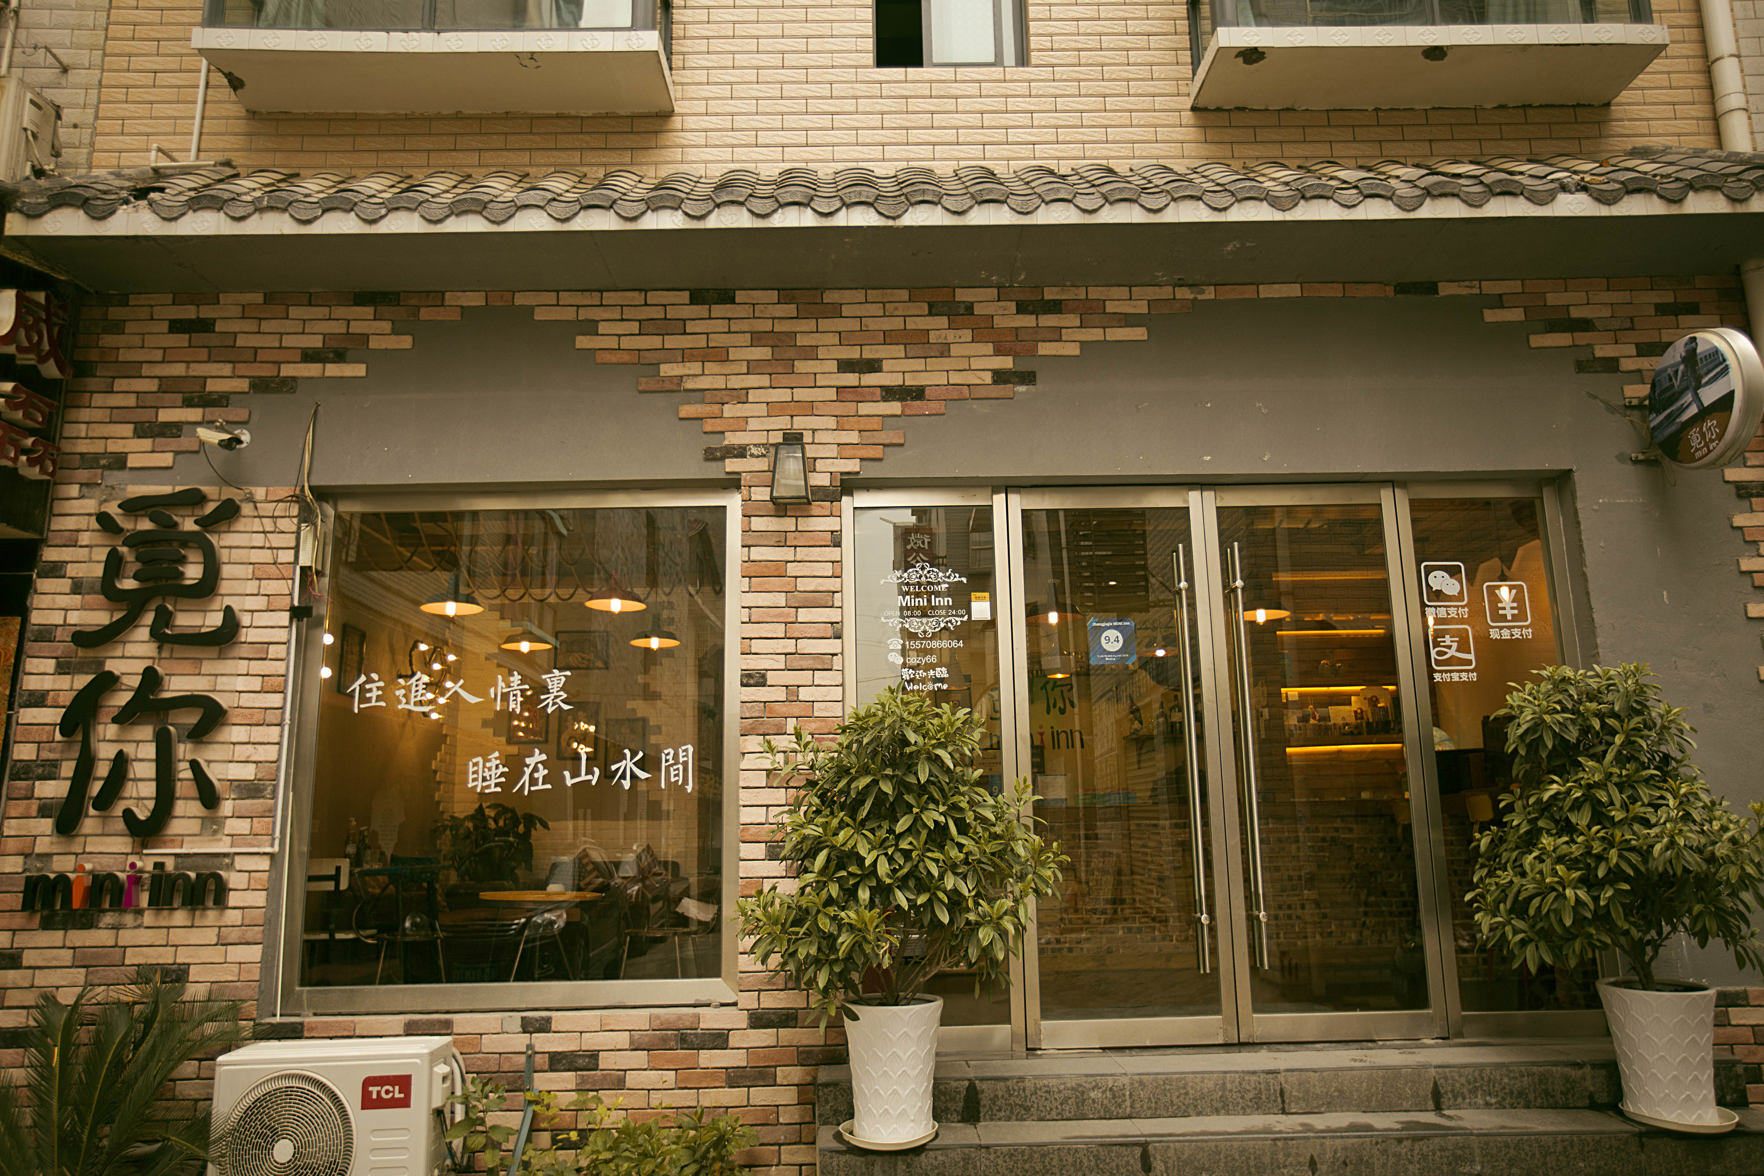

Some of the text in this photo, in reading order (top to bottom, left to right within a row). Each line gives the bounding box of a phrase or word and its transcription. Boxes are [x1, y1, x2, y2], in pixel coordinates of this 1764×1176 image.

[898, 595, 952, 606] Mini Inn
[1425, 607, 1469, 618] 微信支付
[1104, 635, 1120, 644] 9.4
[1490, 628, 1533, 640] 现金支付
[906, 640, 964, 649] 15570866064
[1433, 672, 1477, 682] 支付宝支付
[346, 669, 574, 714] 住進人情裏
[1050, 725, 1085, 750] inn
[466, 744, 694, 796] 睡在山水間
[21, 861, 228, 912] mini inn
[368, 1085, 405, 1099] TCL
